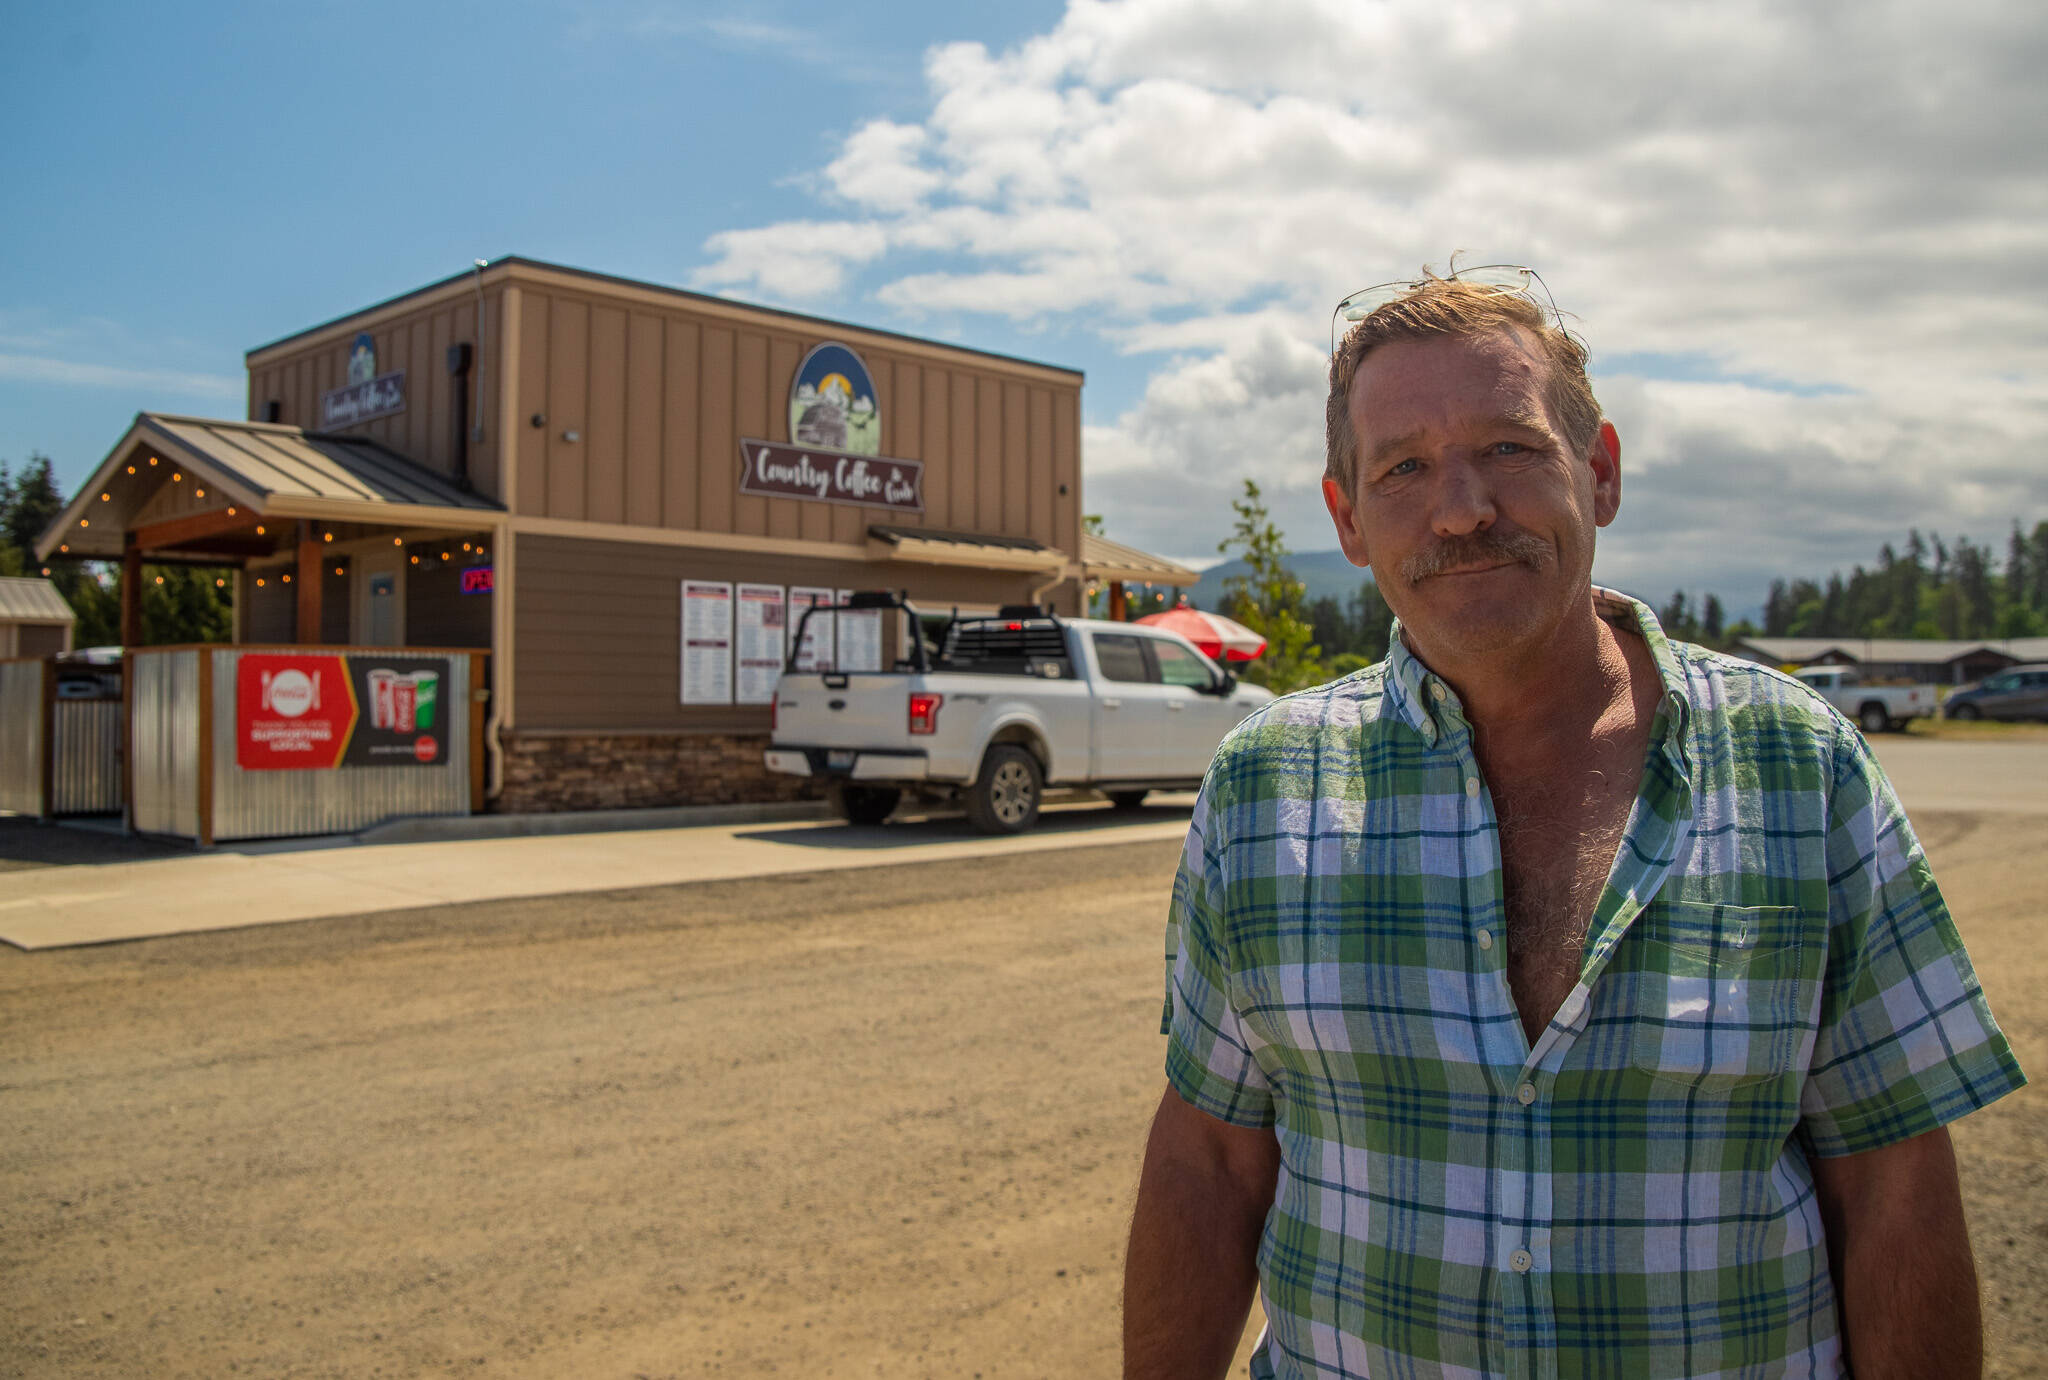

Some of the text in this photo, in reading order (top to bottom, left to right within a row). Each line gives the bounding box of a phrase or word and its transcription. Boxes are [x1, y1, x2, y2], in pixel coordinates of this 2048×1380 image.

[757, 447, 881, 498] Country Coffee
[251, 729, 333, 741] SUPPORTING
